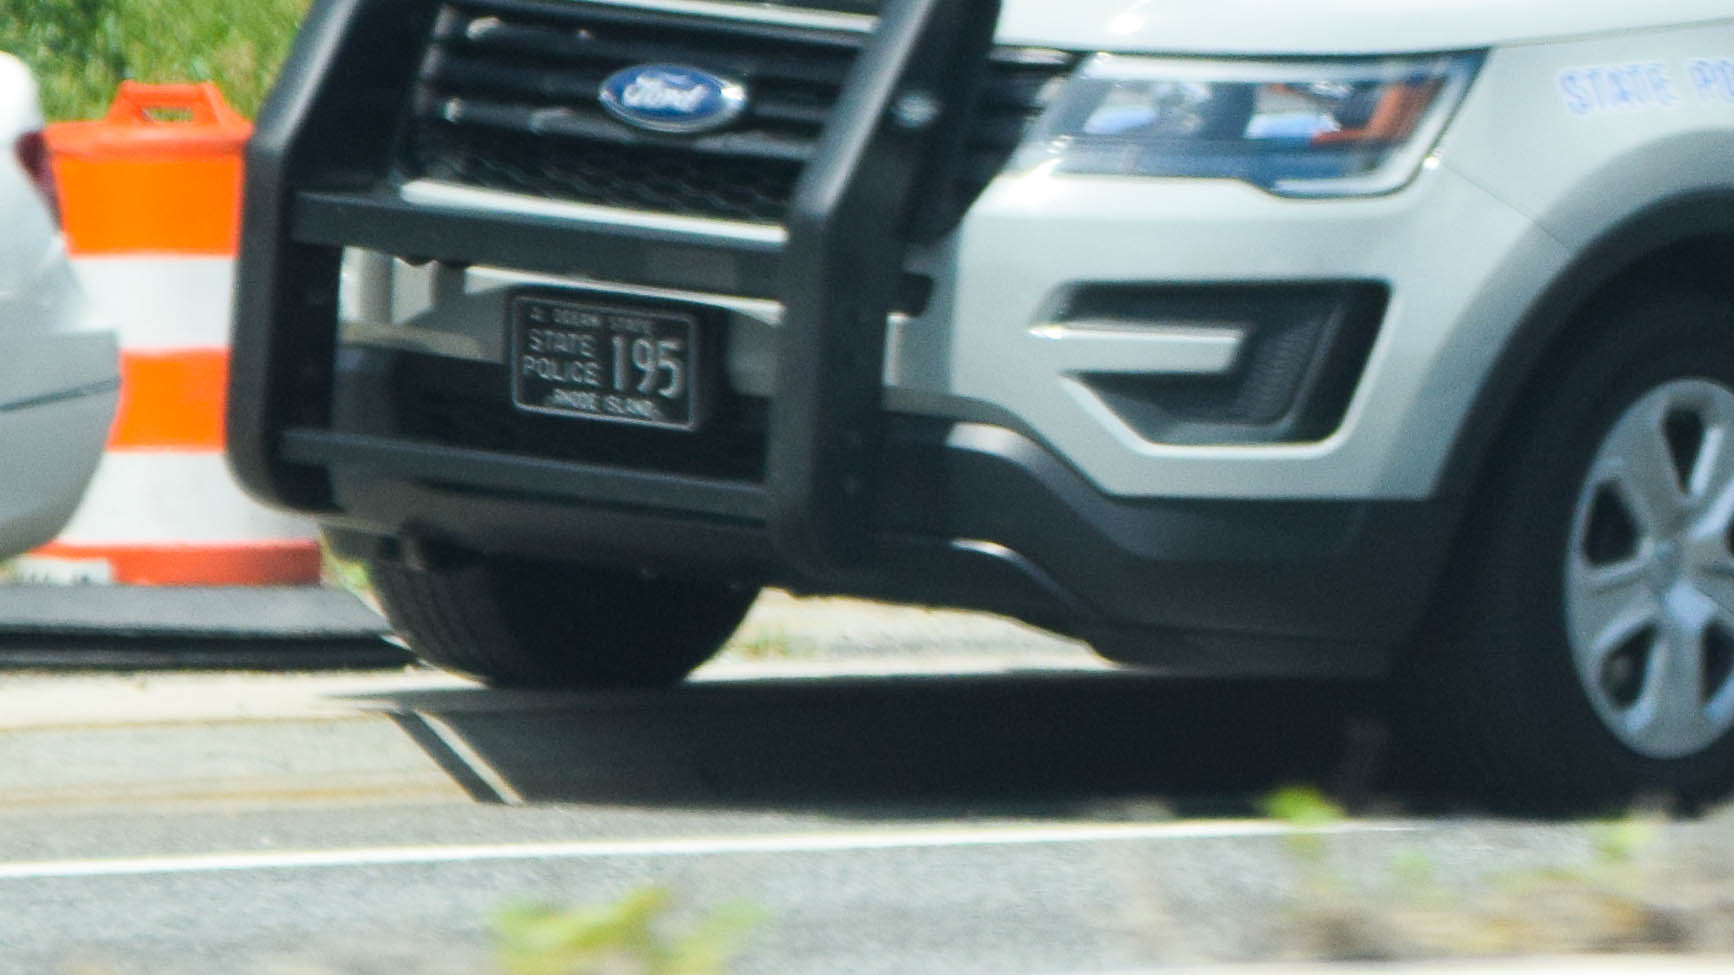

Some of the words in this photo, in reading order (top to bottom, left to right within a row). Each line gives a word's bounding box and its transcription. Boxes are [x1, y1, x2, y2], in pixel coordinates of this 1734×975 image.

[623, 73, 708, 113] Ford
[1559, 60, 1679, 115] STATE
[528, 328, 596, 358] STATE
[522, 355, 601, 387] POLICE
[611, 335, 686, 399] 195
